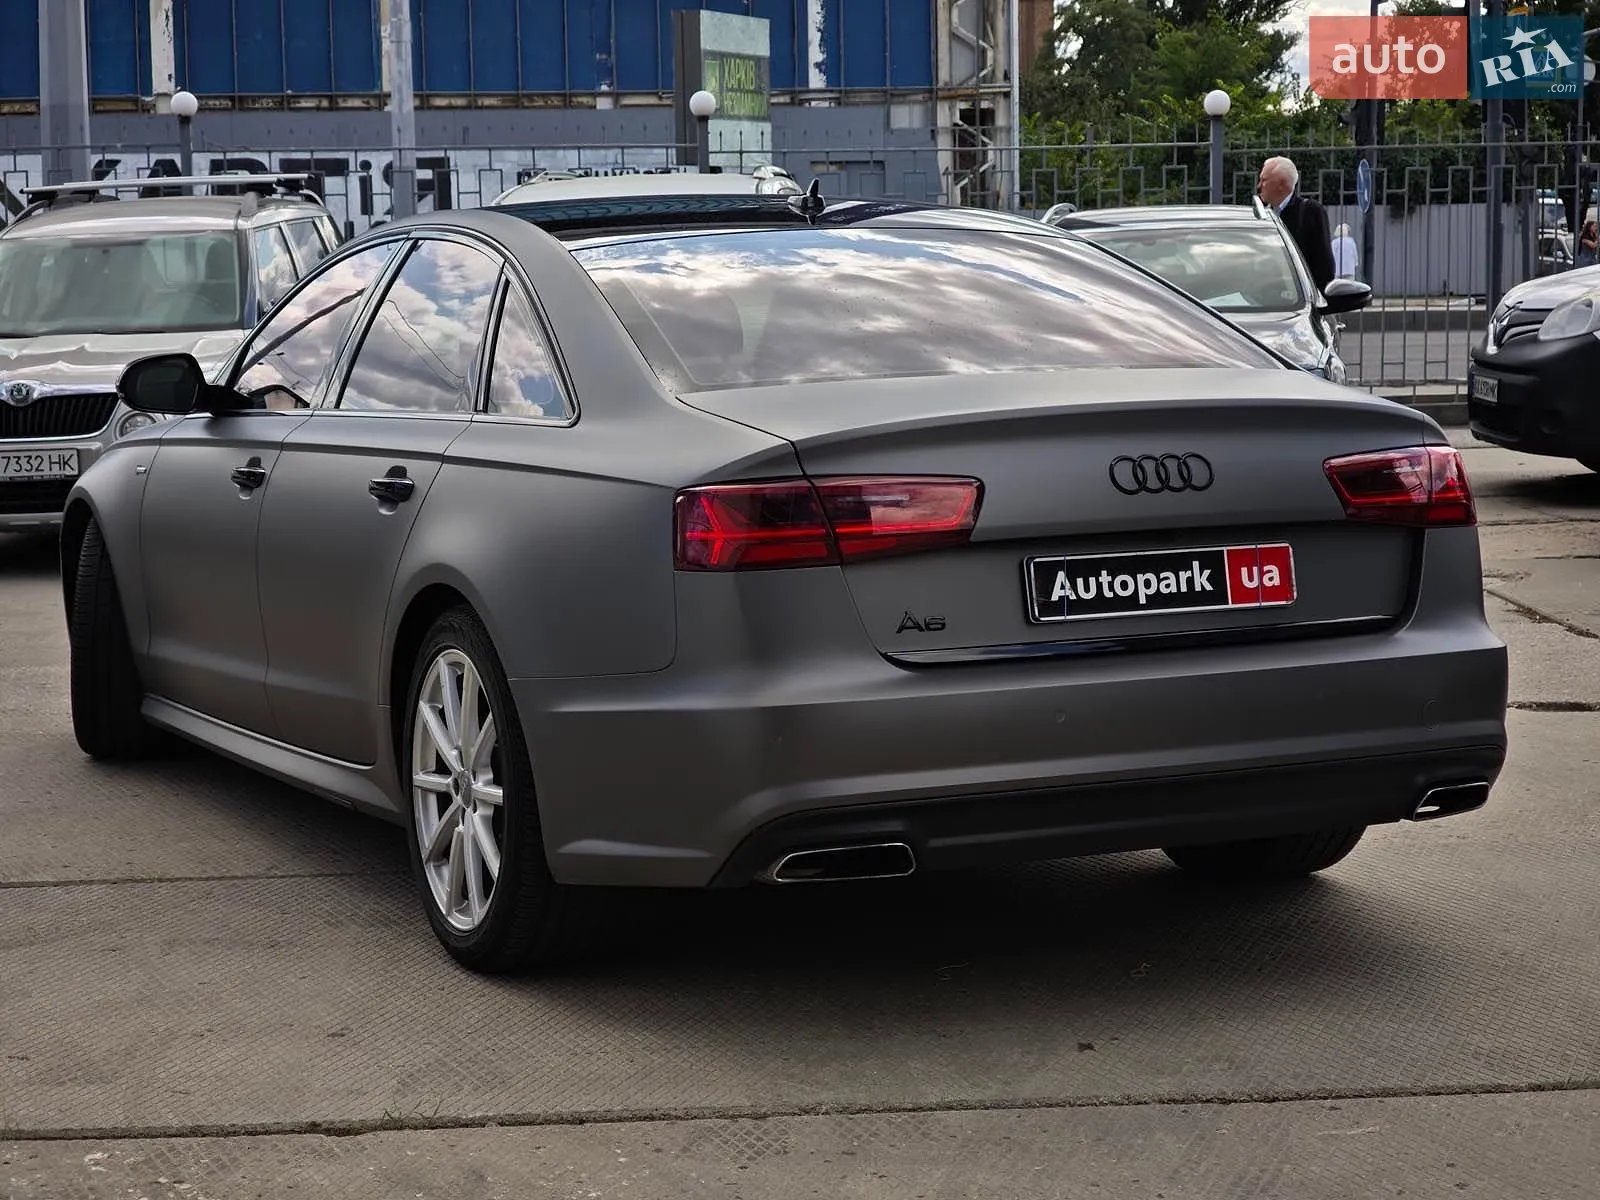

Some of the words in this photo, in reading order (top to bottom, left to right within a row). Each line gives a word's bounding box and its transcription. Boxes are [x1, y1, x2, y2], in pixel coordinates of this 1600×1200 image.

[0, 455, 45, 474] 7332
[1050, 560, 1214, 605] Autopark
[1240, 564, 1281, 589] ua
[895, 610, 947, 634] A6
